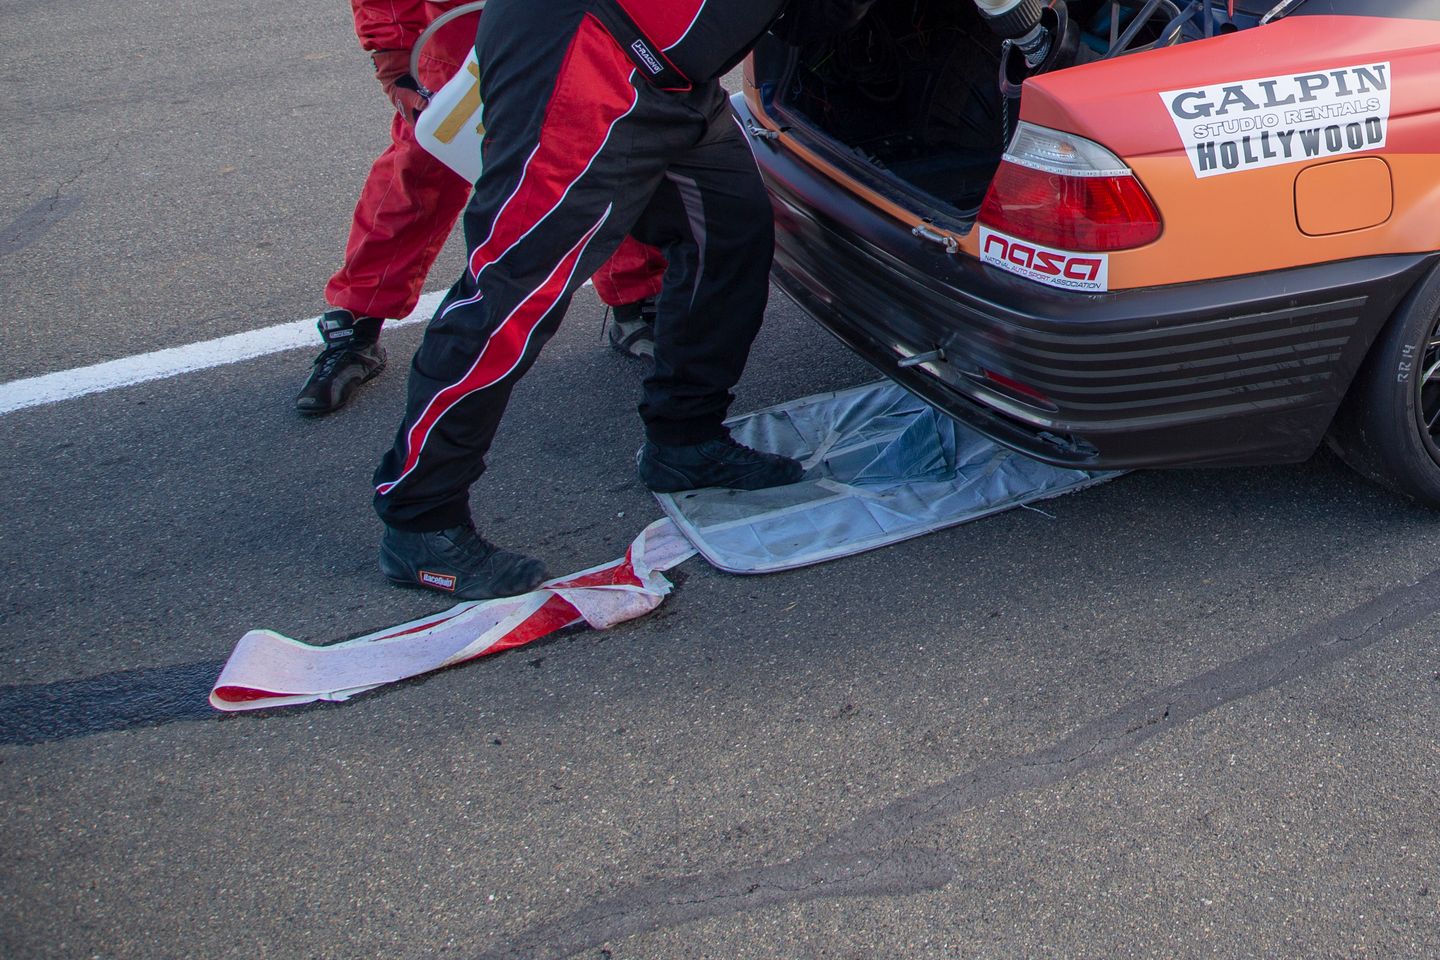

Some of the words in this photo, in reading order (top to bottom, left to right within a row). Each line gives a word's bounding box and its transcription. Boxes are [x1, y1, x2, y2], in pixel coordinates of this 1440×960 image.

[1171, 64, 1387, 120] GALPIN
[1193, 112, 1280, 139] STUDIO
[1285, 97, 1381, 125] RENTALS
[1196, 116, 1384, 172] HOLLYWOOD
[984, 234, 1102, 281] nasa
[985, 255, 1011, 270] NATIONAL
[1011, 263, 1028, 276] AUTO
[1028, 270, 1050, 282] SPORT
[1051, 277, 1101, 289] ASSOCIATION
[1402, 344, 1416, 358] 14
